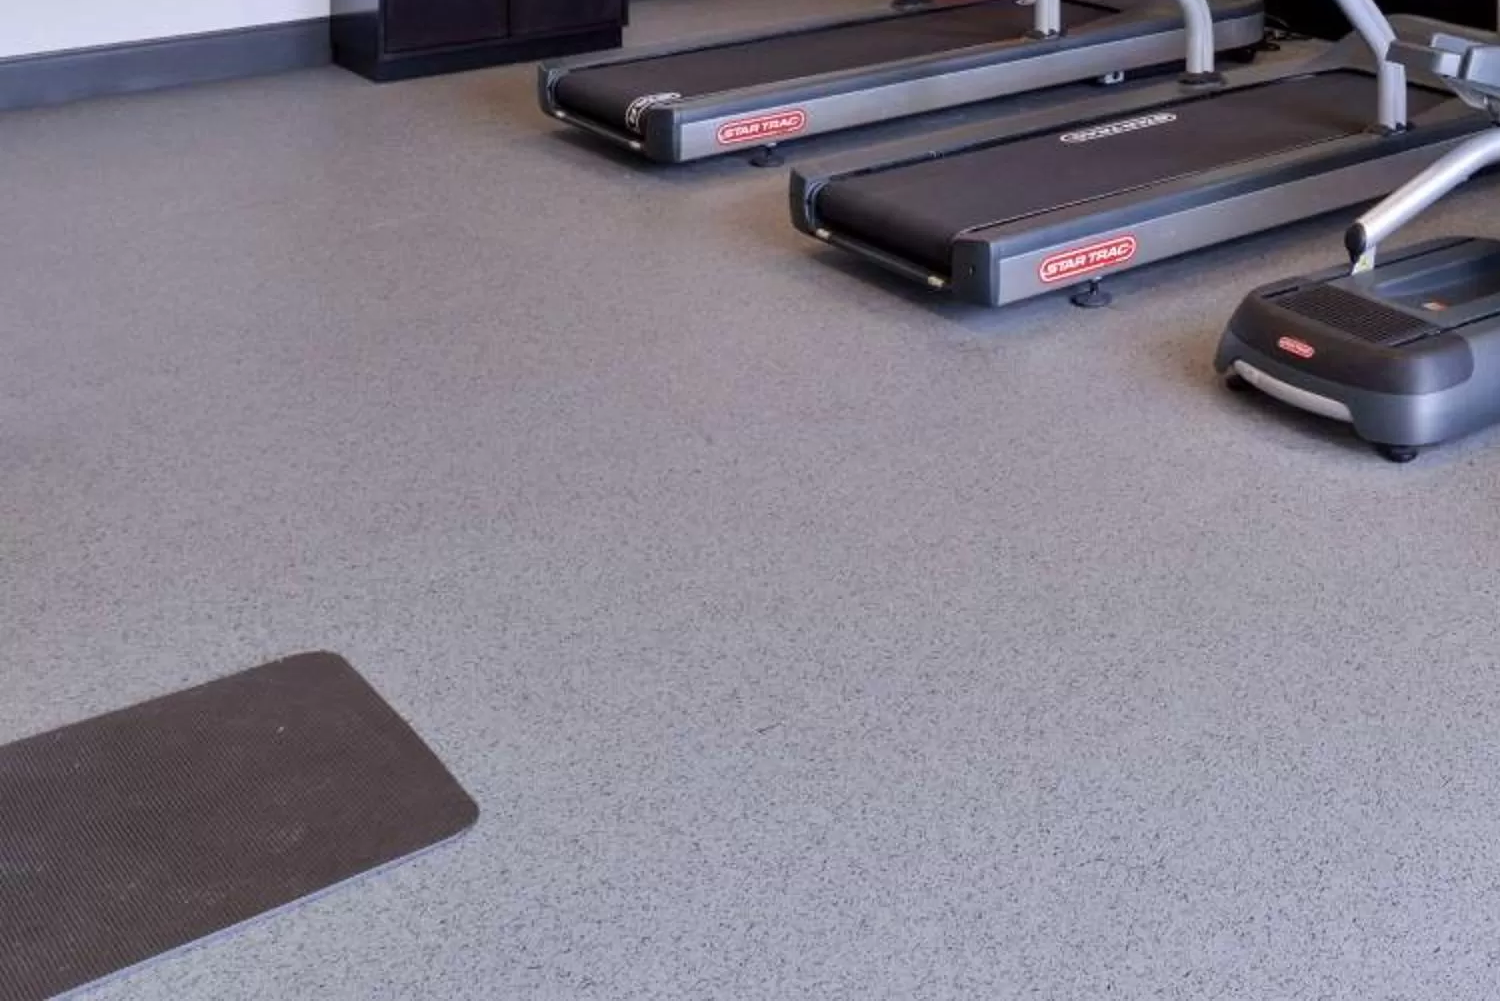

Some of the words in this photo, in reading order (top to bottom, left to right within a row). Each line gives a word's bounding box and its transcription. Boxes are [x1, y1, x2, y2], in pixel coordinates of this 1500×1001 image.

[725, 123, 760, 138] STAR
[761, 116, 799, 131] TRAC
[1047, 254, 1087, 274] STAR
[1087, 242, 1130, 264] TRAC
